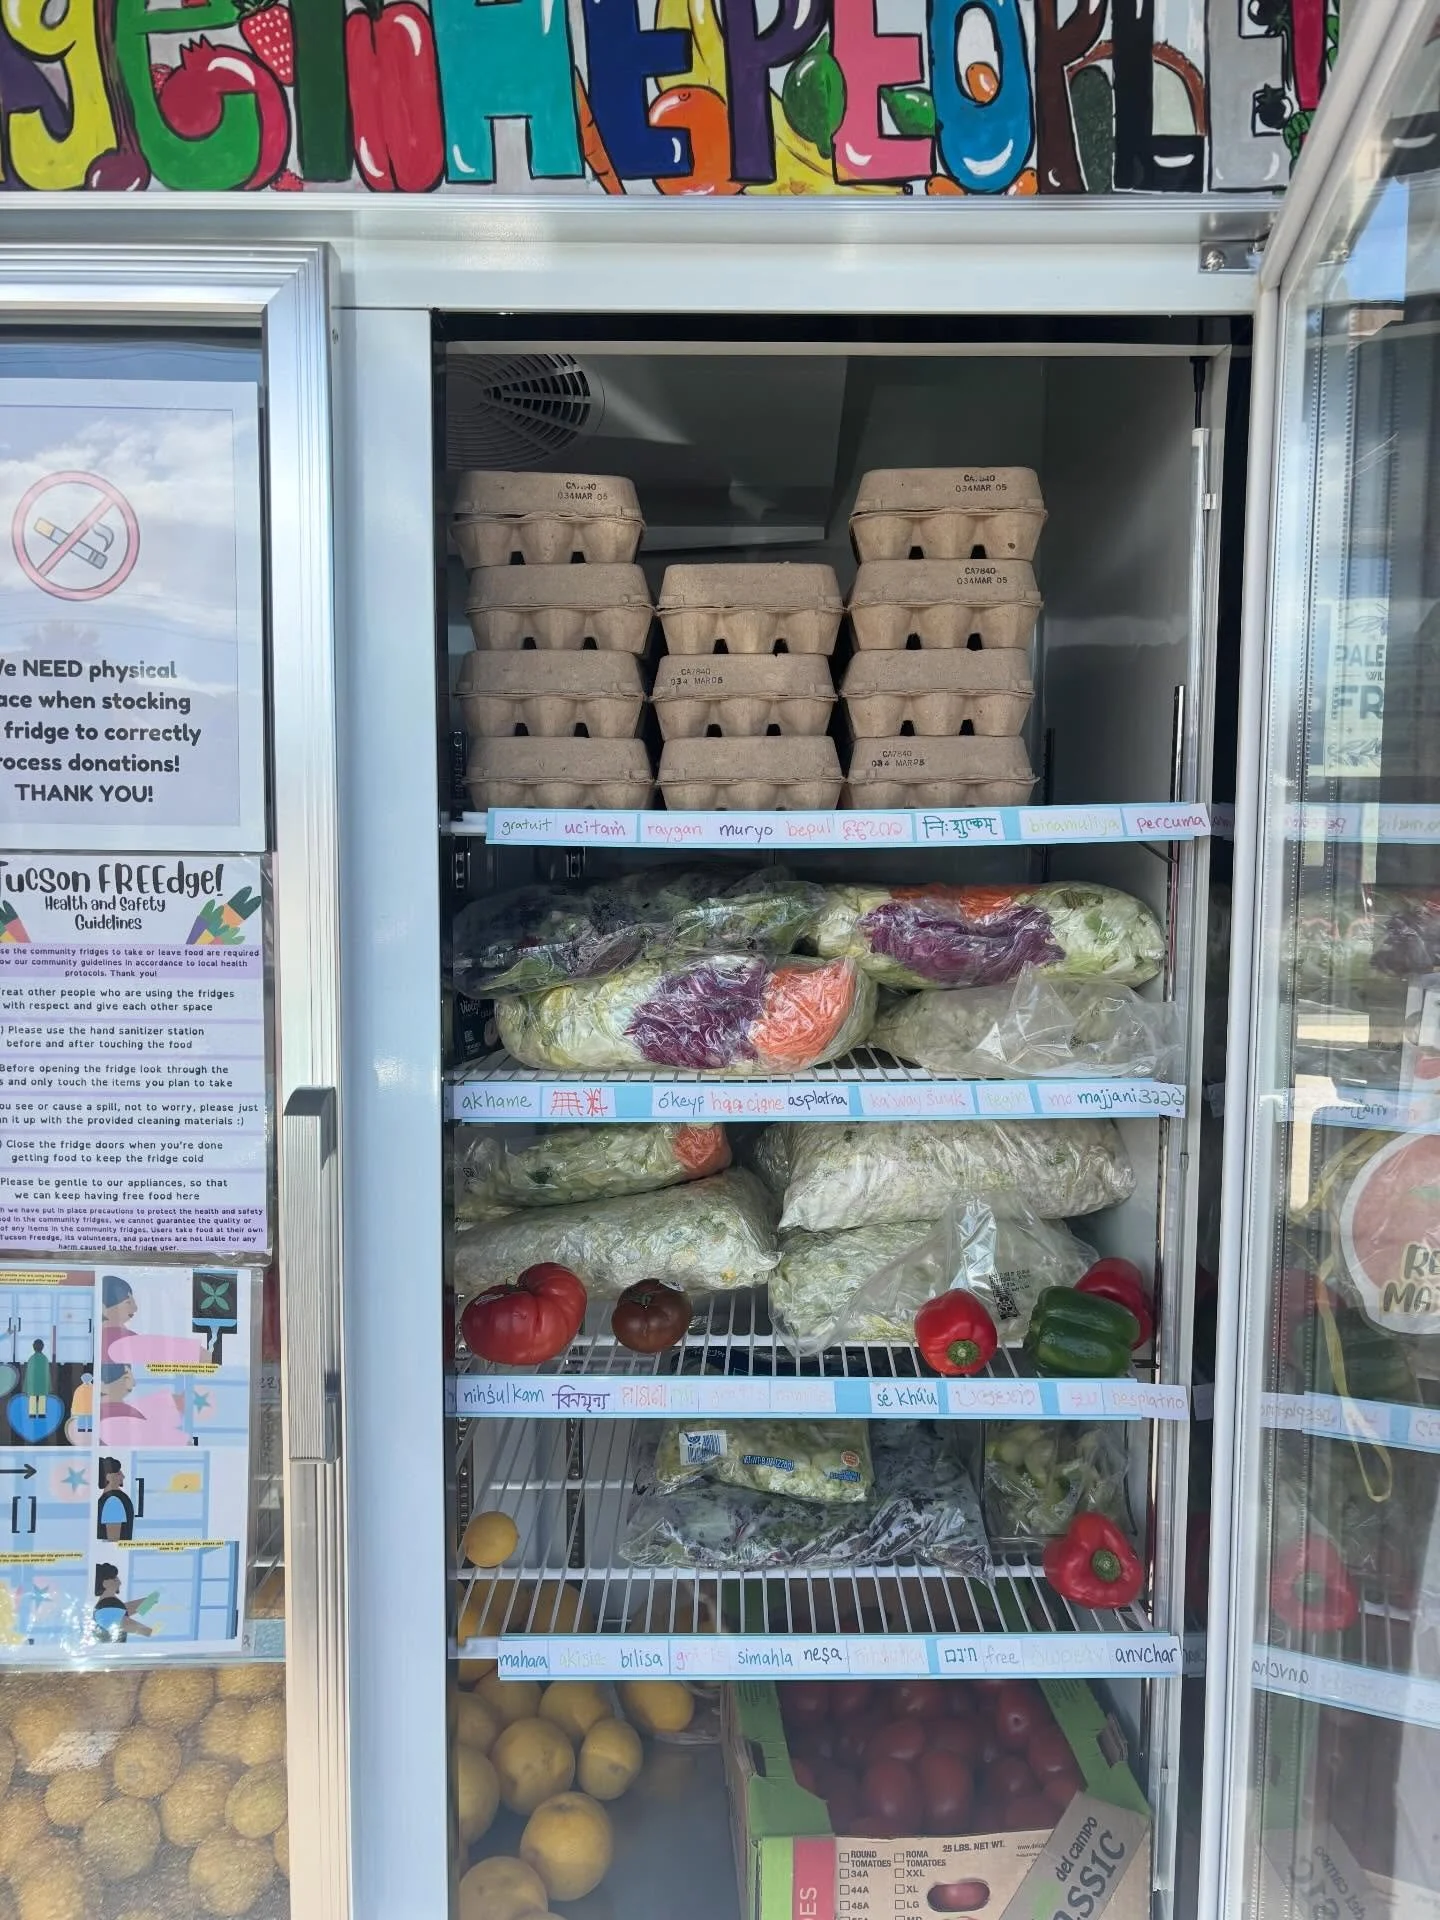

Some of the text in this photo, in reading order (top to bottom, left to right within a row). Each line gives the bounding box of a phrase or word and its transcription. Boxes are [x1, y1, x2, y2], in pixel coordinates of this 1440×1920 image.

[22, 658, 83, 677] NEED
[89, 660, 177, 684] physical
[38, 691, 95, 709] when
[101, 693, 190, 714] stocking
[3, 720, 201, 746] fridge to correctly
[67, 754, 179, 772] donations!
[14, 783, 153, 802] THANK YOU!
[1137, 815, 1206, 831] percuma
[502, 819, 552, 834] gratuit
[719, 823, 773, 844] muryo
[98, 860, 224, 898] FREEdge!
[44, 894, 165, 912] Health and Safety
[74, 914, 142, 930] Guidelines
[139, 970, 157, 978] you!
[27, 988, 56, 996] other
[60, 988, 95, 1000] people
[99, 988, 120, 997] who
[145, 989, 172, 999] using
[176, 989, 193, 998] the
[198, 989, 234, 1000] fridges
[2, 1001, 212, 1013] with respect and give each other space
[7, 1026, 42, 1034] Please
[68, 1026, 86, 1034] the
[90, 1026, 115, 1035] hand
[118, 1026, 164, 1035] sanitizer
[167, 1026, 204, 1035] station
[6, 1039, 192, 1050] before and after touching the food
[39, 1064, 79, 1074] opening
[83, 1064, 101, 1072] the
[105, 1064, 136, 1075] fridge
[140, 1064, 162, 1073] look
[167, 1064, 207, 1076] through
[211, 1065, 228, 1074] the
[30, 1078, 53, 1088] only
[57, 1078, 86, 1086] touch
[91, 1078, 108, 1086] the
[112, 1078, 140, 1086] items
[145, 1079, 164, 1088] you
[168, 1078, 190, 1088] plan
[194, 1079, 205, 1087] to
[207, 1078, 232, 1087] take
[1077, 1088, 1137, 1110] majjani
[11, 1153, 204, 1164] getting food to keep the fridge cold
[54, 1191, 80, 1200] keep
[84, 1191, 120, 1202] having
[122, 1191, 144, 1200] free
[148, 1191, 172, 1200] food
[176, 1191, 199, 1200] here
[1383, 1282, 1440, 1312] MA
[498, 1651, 548, 1668] mahara
[620, 1647, 662, 1668] bilisa
[738, 1646, 794, 1666] simahla
[985, 1647, 1020, 1665] free
[1115, 1647, 1178, 1664] anvchar
[1069, 1816, 1098, 1860] campo
[850, 1850, 877, 1858] ROUND
[906, 1850, 928, 1858] ROMA
[851, 1859, 891, 1867] TOMATOES
[906, 1859, 946, 1867] TOMATOES
[850, 1870, 869, 1878] 34A
[850, 1886, 869, 1894] 44A
[906, 1901, 919, 1909] LG
